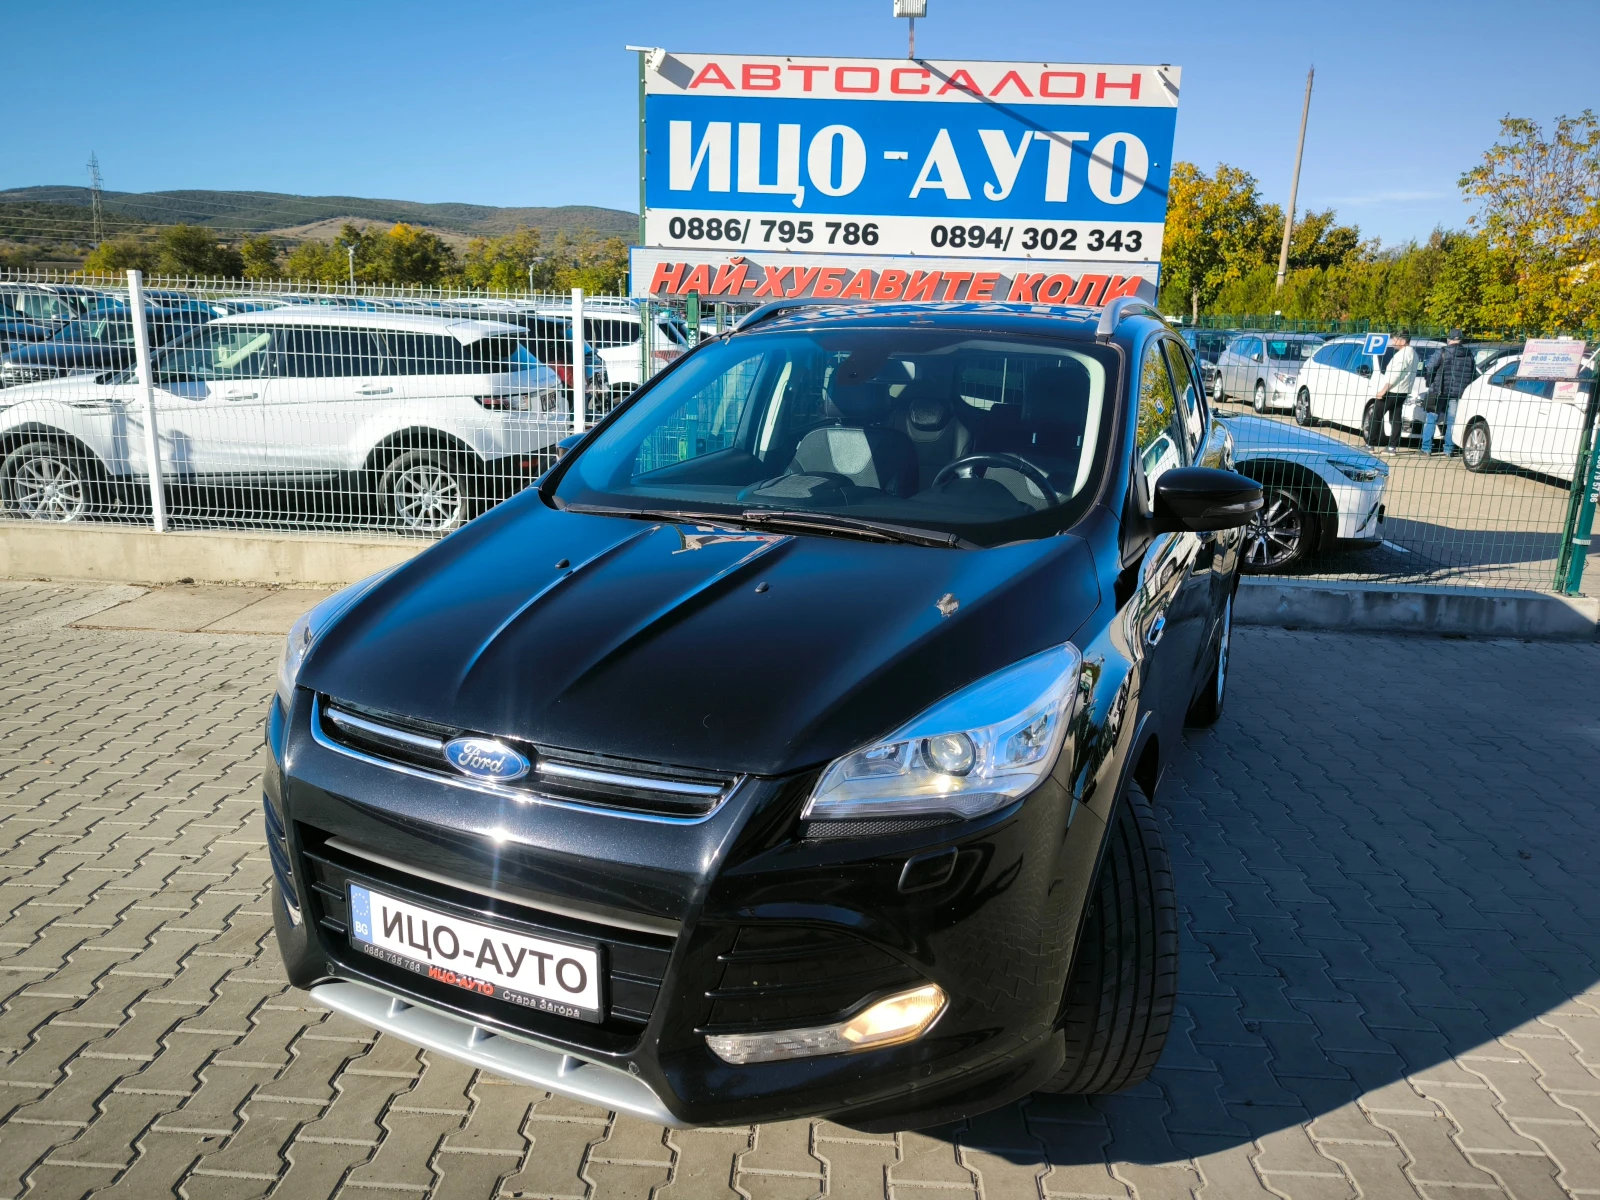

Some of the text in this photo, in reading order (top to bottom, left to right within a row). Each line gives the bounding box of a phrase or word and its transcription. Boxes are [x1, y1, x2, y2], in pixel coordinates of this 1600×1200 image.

[689, 62, 1142, 100] АВТОСАЛОН
[668, 216, 880, 246] 0886/ 795 786
[930, 224, 1143, 253] 0894/ 302 343
[648, 256, 1143, 307] НАЙ-ХУБАВИТЕ КОЛИ
[1367, 335, 1384, 353] P
[457, 742, 506, 774] Ford
[355, 920, 369, 936] BG
[363, 944, 421, 974] 0886 795 786
[381, 905, 588, 995] ИЦО-АУТО
[427, 964, 495, 997] ИЦО-АУТО
[502, 989, 580, 1019] Стара Загора
